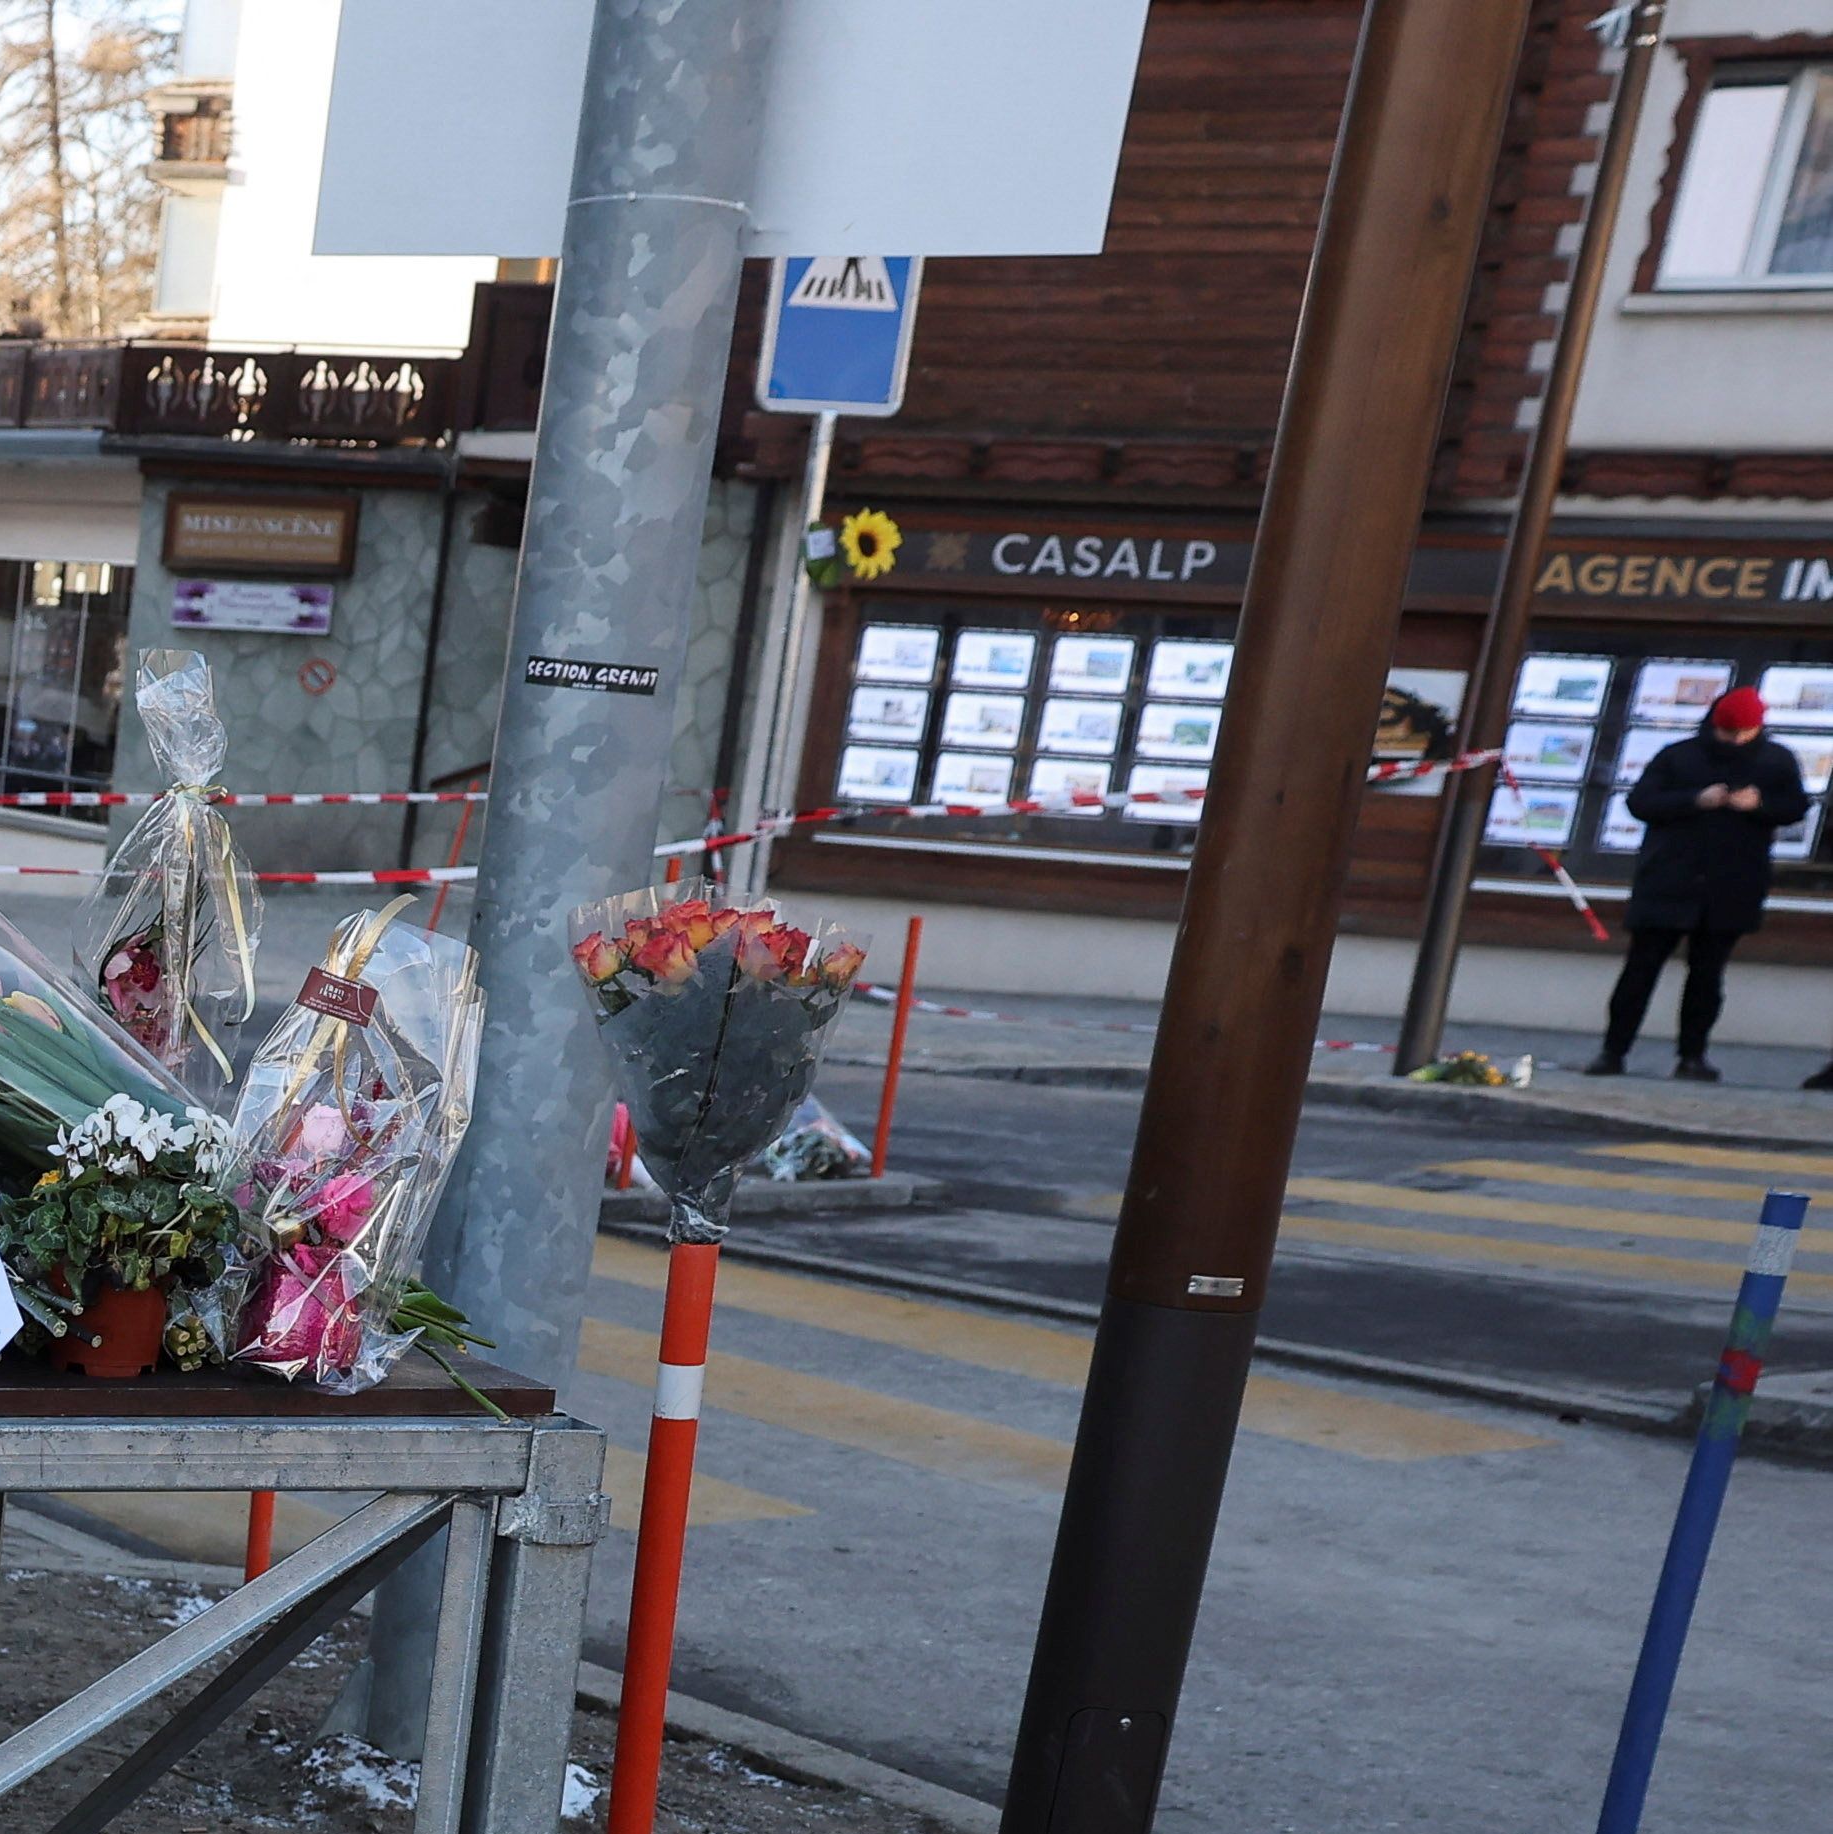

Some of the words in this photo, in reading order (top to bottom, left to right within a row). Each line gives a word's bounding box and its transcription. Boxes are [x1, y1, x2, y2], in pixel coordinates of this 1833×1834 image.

[991, 533, 1217, 582] CASALP
[1534, 553, 1774, 599] AGENCE
[527, 660, 593, 681] SECTION
[595, 667, 659, 687] GRENAT
